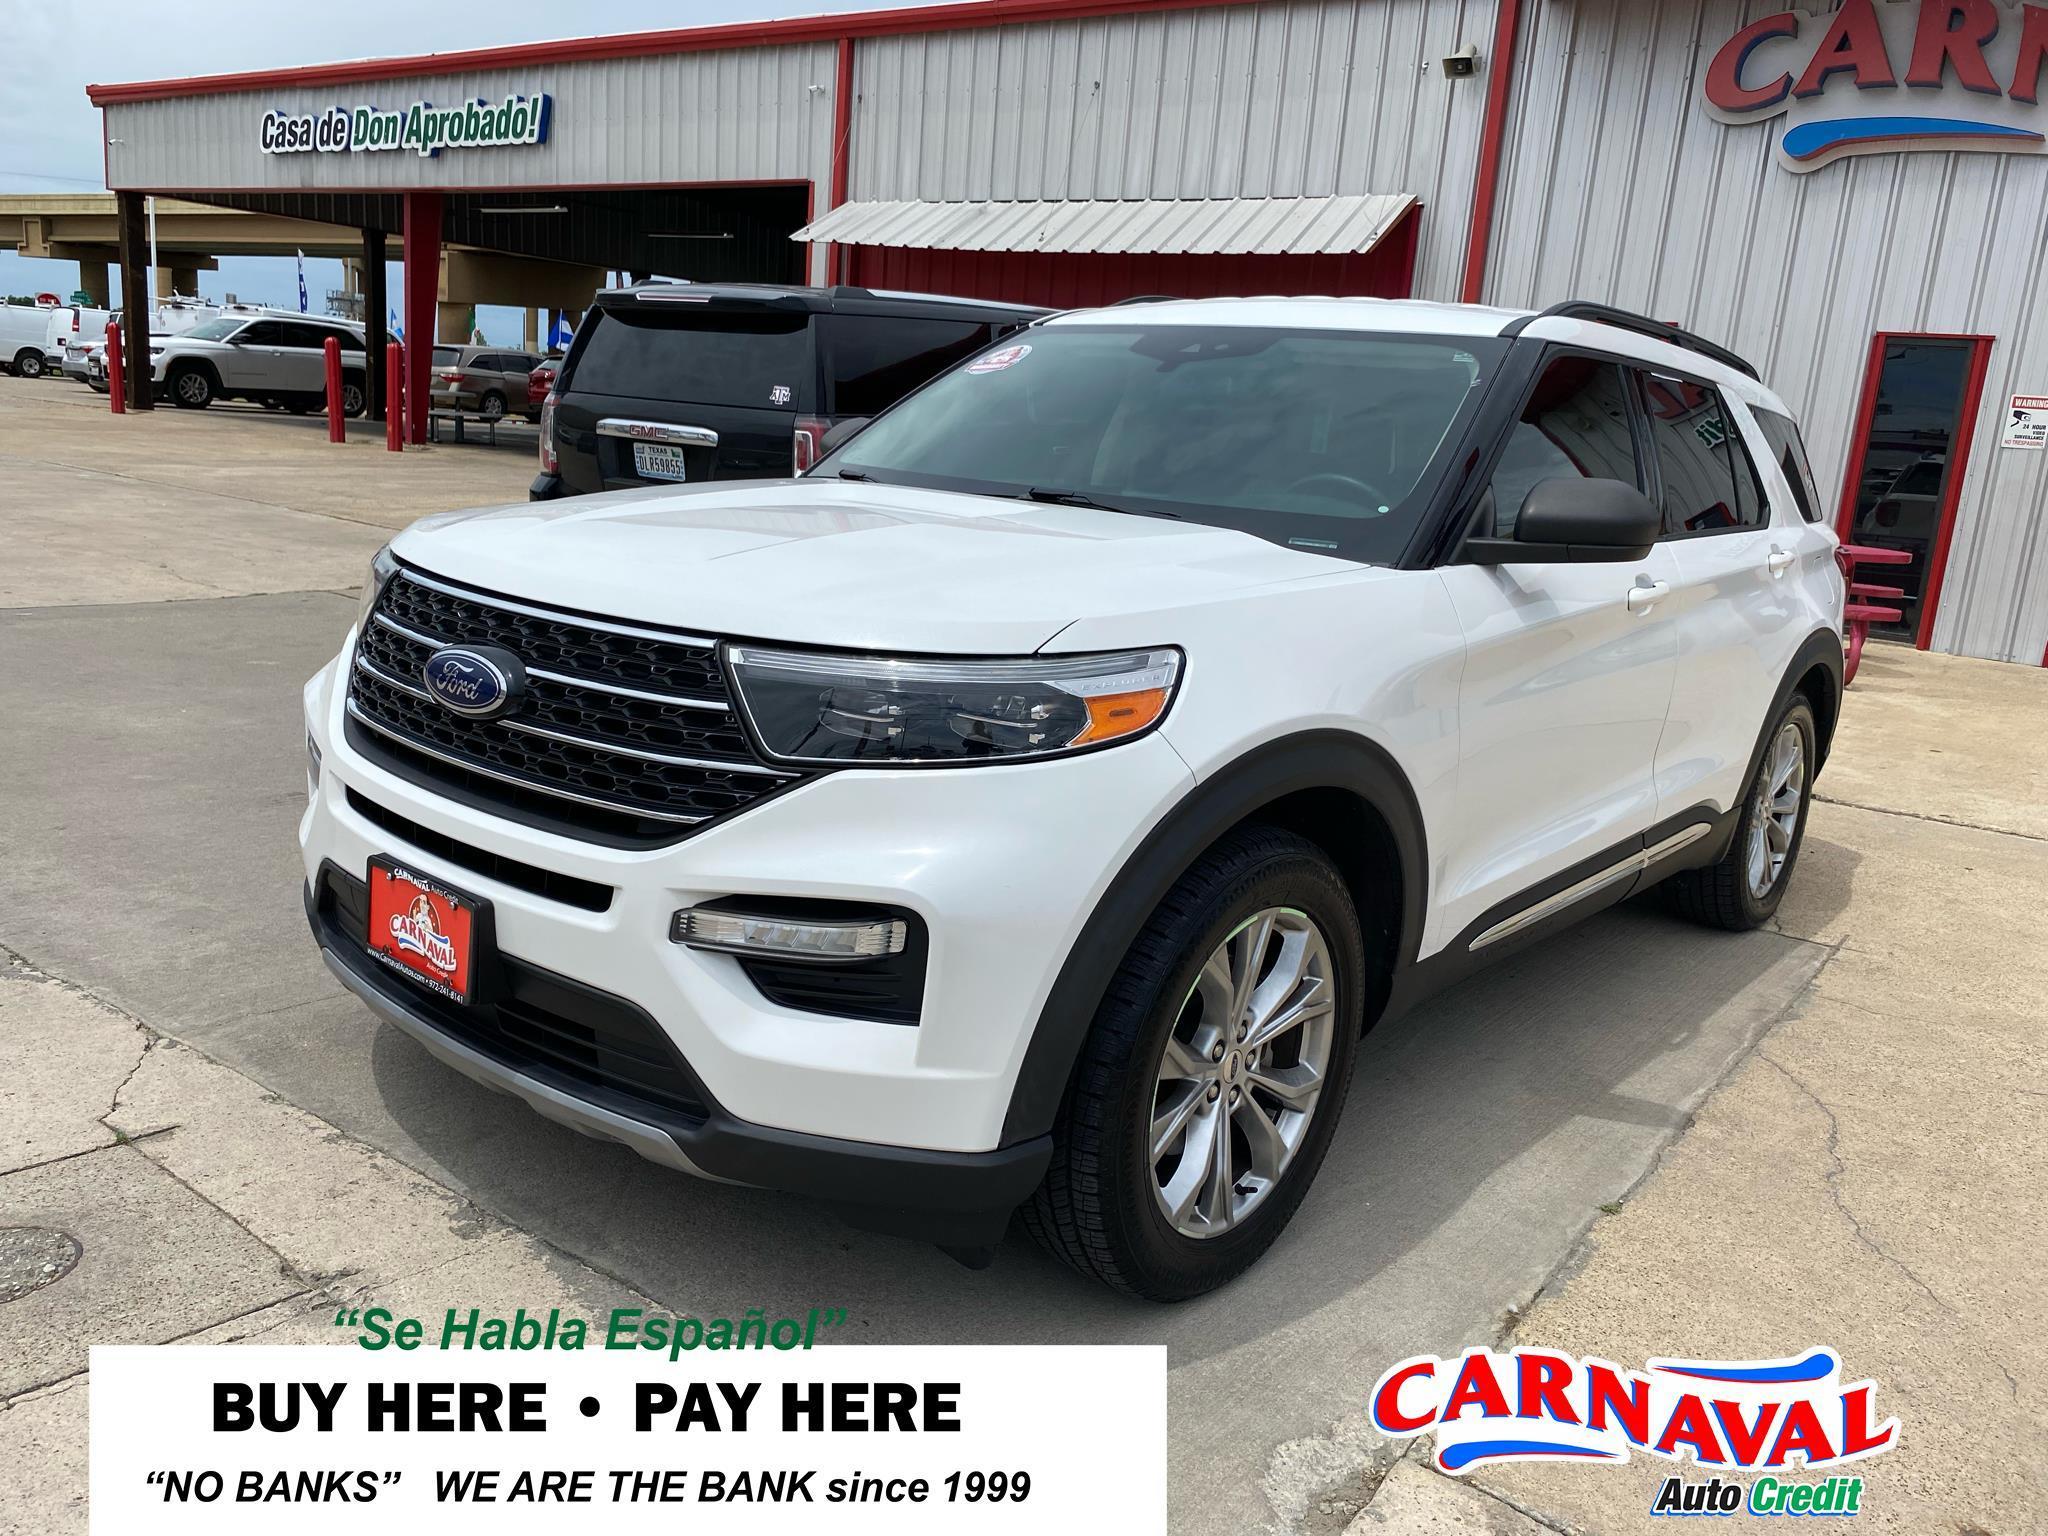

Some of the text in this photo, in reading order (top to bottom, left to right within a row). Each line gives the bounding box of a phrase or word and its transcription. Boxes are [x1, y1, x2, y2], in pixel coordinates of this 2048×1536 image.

[262, 97, 540, 152] Casa de Don Aprobado!
[629, 425, 668, 440] GMC
[648, 446, 668, 454] TEXAS
[639, 456, 681, 475] DLR59855
[437, 661, 483, 700] Ford
[394, 868, 430, 892] CARNAVAL
[431, 884, 443, 897] Auto
[390, 916, 455, 965] CARNAVAL
[367, 947, 464, 1005] www.CarnavalAutos.com 972-241-8141
[426, 962, 437, 973] Auto
